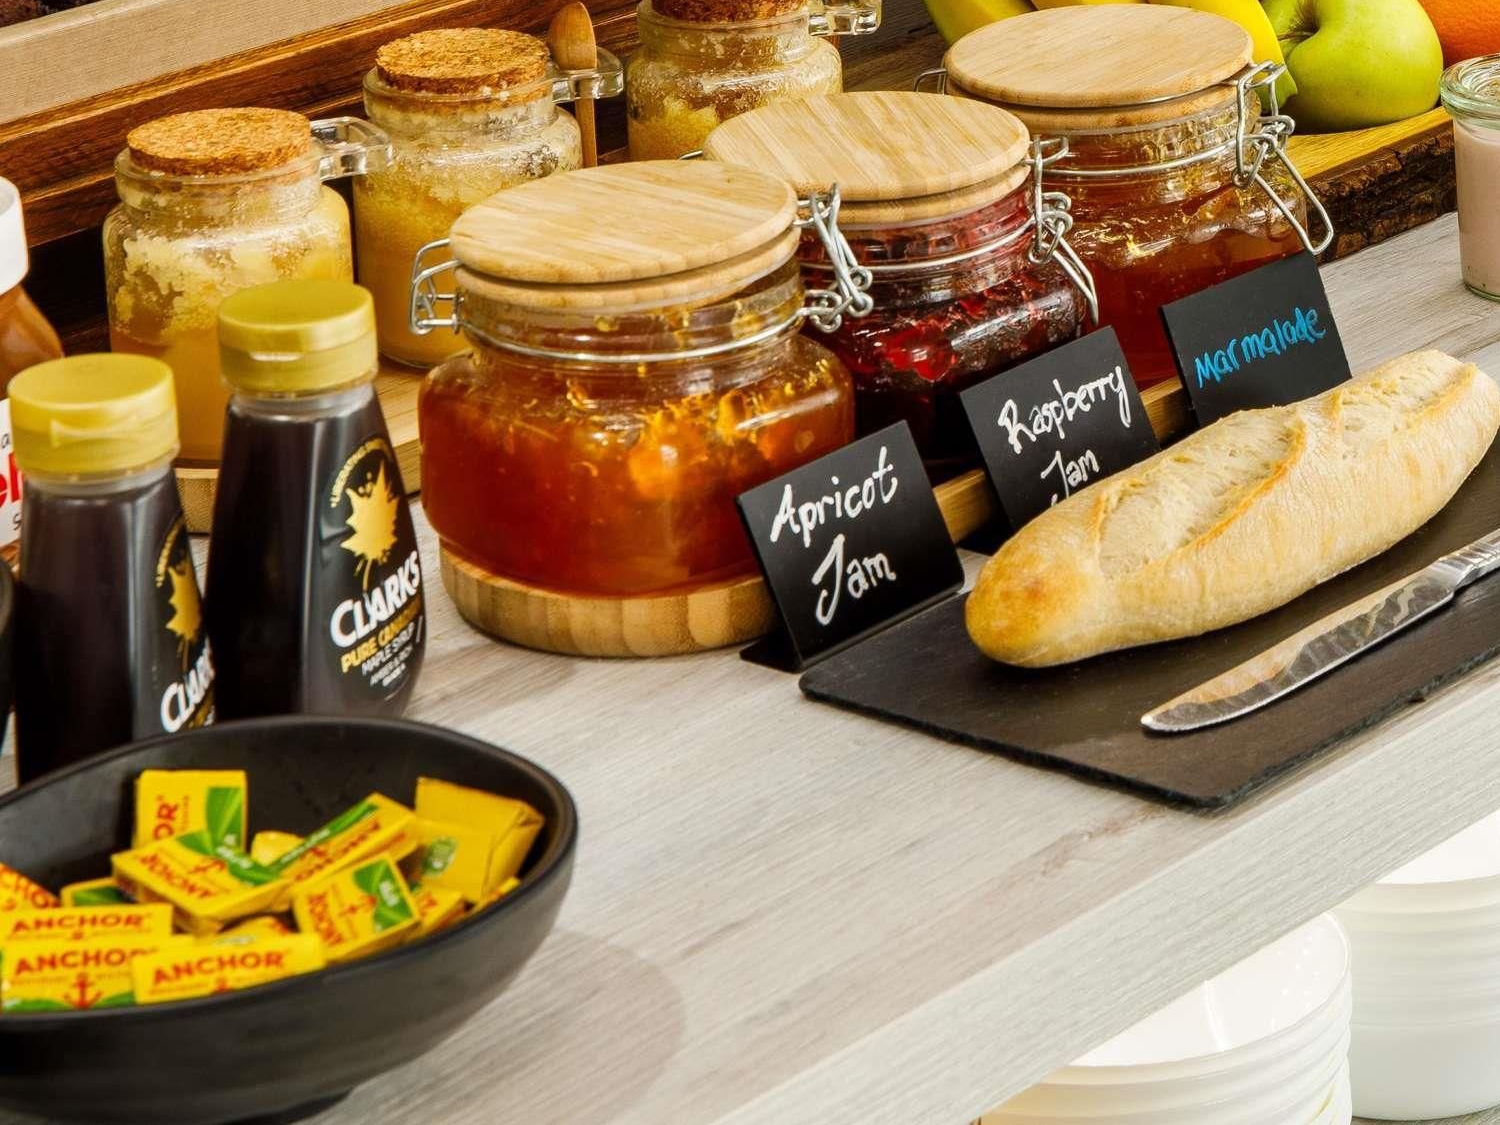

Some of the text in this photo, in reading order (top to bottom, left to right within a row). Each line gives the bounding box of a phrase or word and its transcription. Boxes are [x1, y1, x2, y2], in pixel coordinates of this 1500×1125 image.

[1194, 304, 1326, 389] Marmalade
[997, 364, 1133, 455] Raspberry
[770, 445, 898, 548] Apricot
[1040, 449, 1100, 507] Jam
[811, 533, 896, 625] Jam
[341, 635, 377, 674] PURE
[13, 913, 144, 933] ANCHOR
[15, 947, 146, 976] ANCHO
[153, 951, 285, 986] ANCHOR
